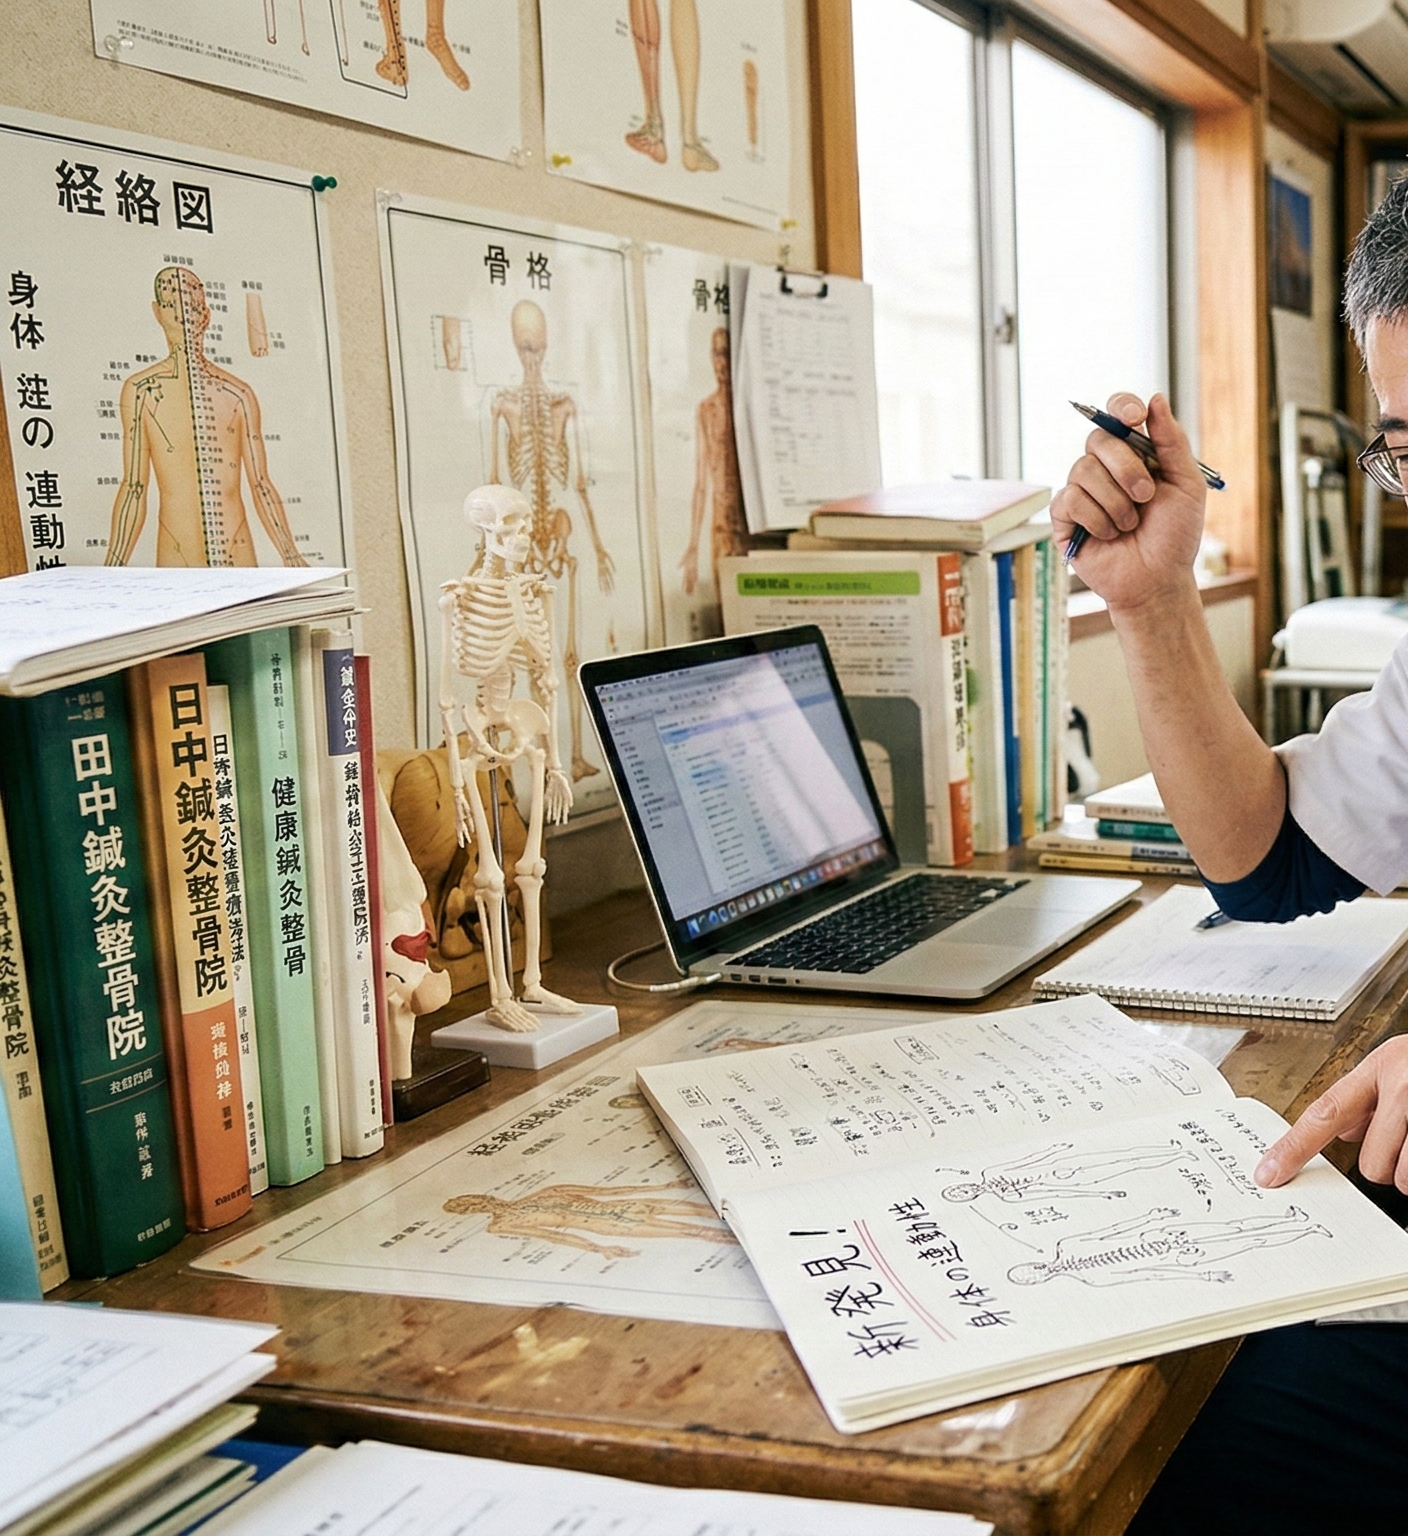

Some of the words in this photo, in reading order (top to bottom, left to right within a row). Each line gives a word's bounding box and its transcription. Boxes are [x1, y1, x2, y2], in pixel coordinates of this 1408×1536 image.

[56, 159, 214, 234] 経絡図
[484, 244, 552, 291] 骨格
[71, 733, 147, 1061] 田中鍼灸整骨院
[168, 682, 227, 998] 日中鍼灸整骨院
[271, 775, 306, 977] 健康鍼灸整骨
[789, 1228, 919, 1358] 新発見!
[889, 1197, 1016, 1327] 身体の連動性
